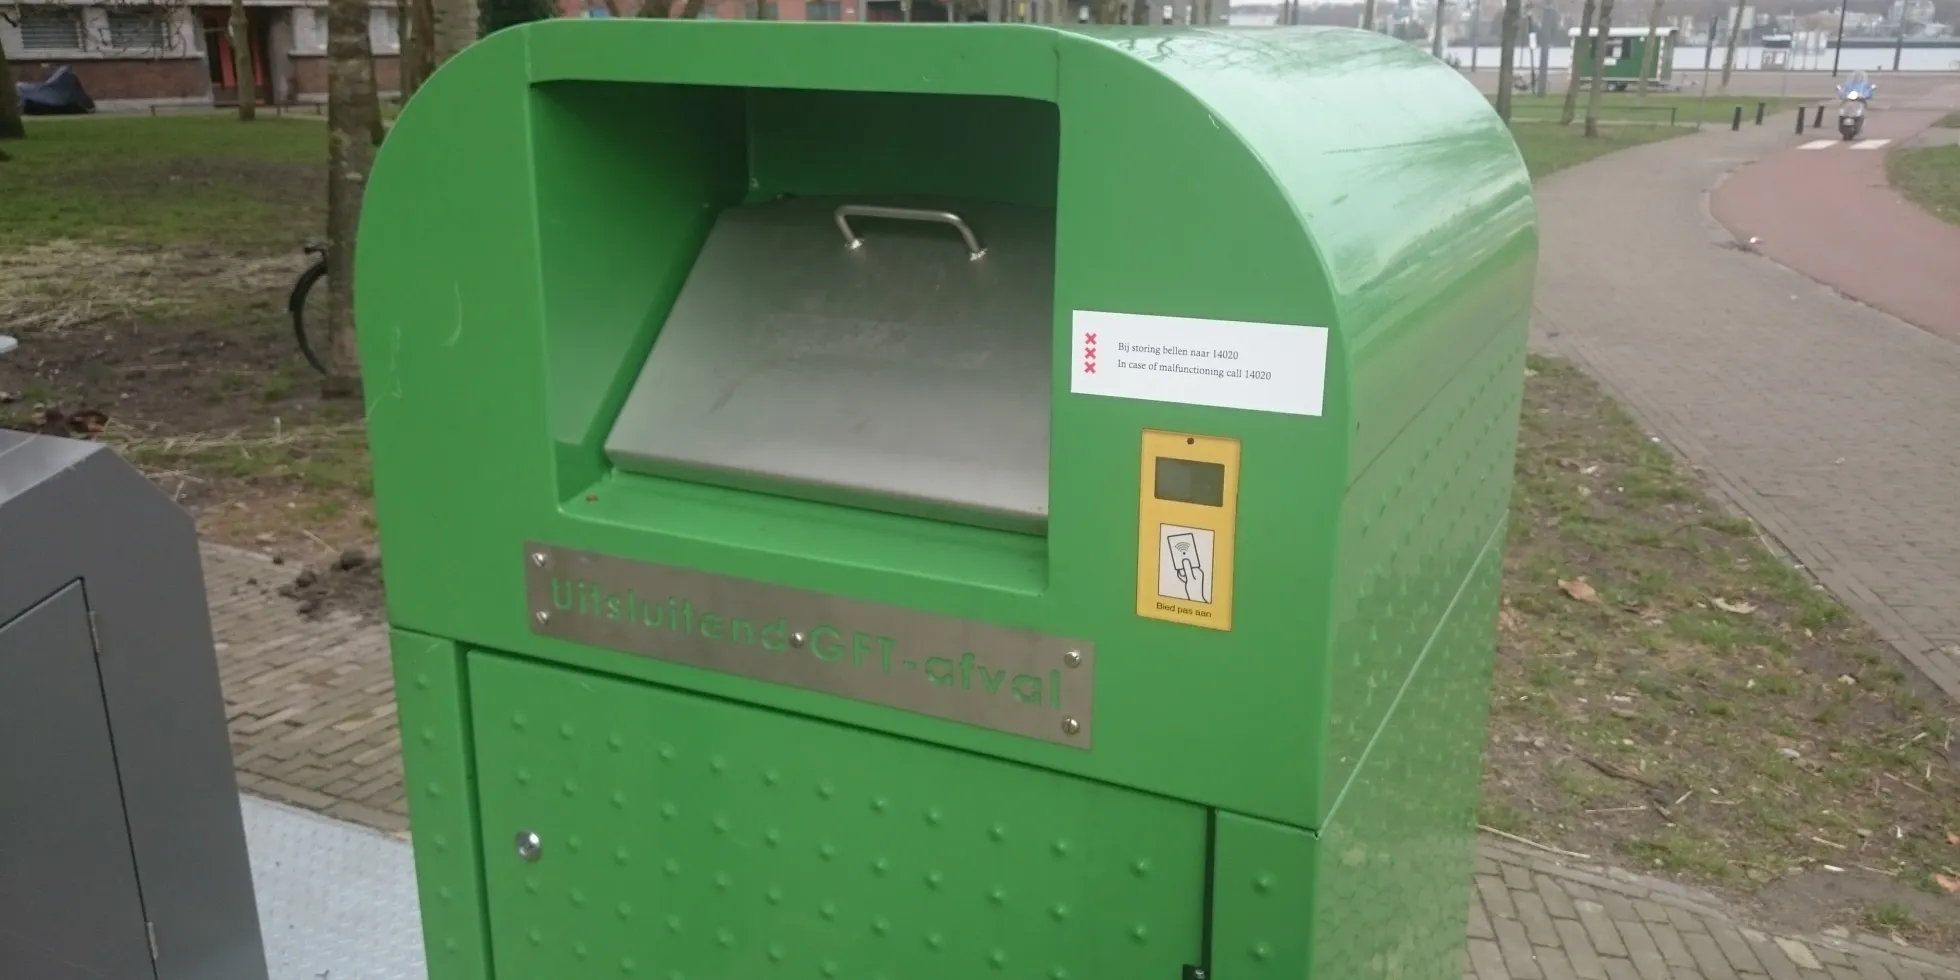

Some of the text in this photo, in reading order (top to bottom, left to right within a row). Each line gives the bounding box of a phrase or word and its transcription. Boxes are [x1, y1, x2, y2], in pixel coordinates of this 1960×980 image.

[1117, 342, 1239, 360] Bij storing bellen naar 14020
[1117, 360, 1272, 380] In case of malfunctioning call 14020
[1156, 602, 1212, 618] Bied pas aan
[550, 576, 1061, 710] Uitsluitend GFT-afval
